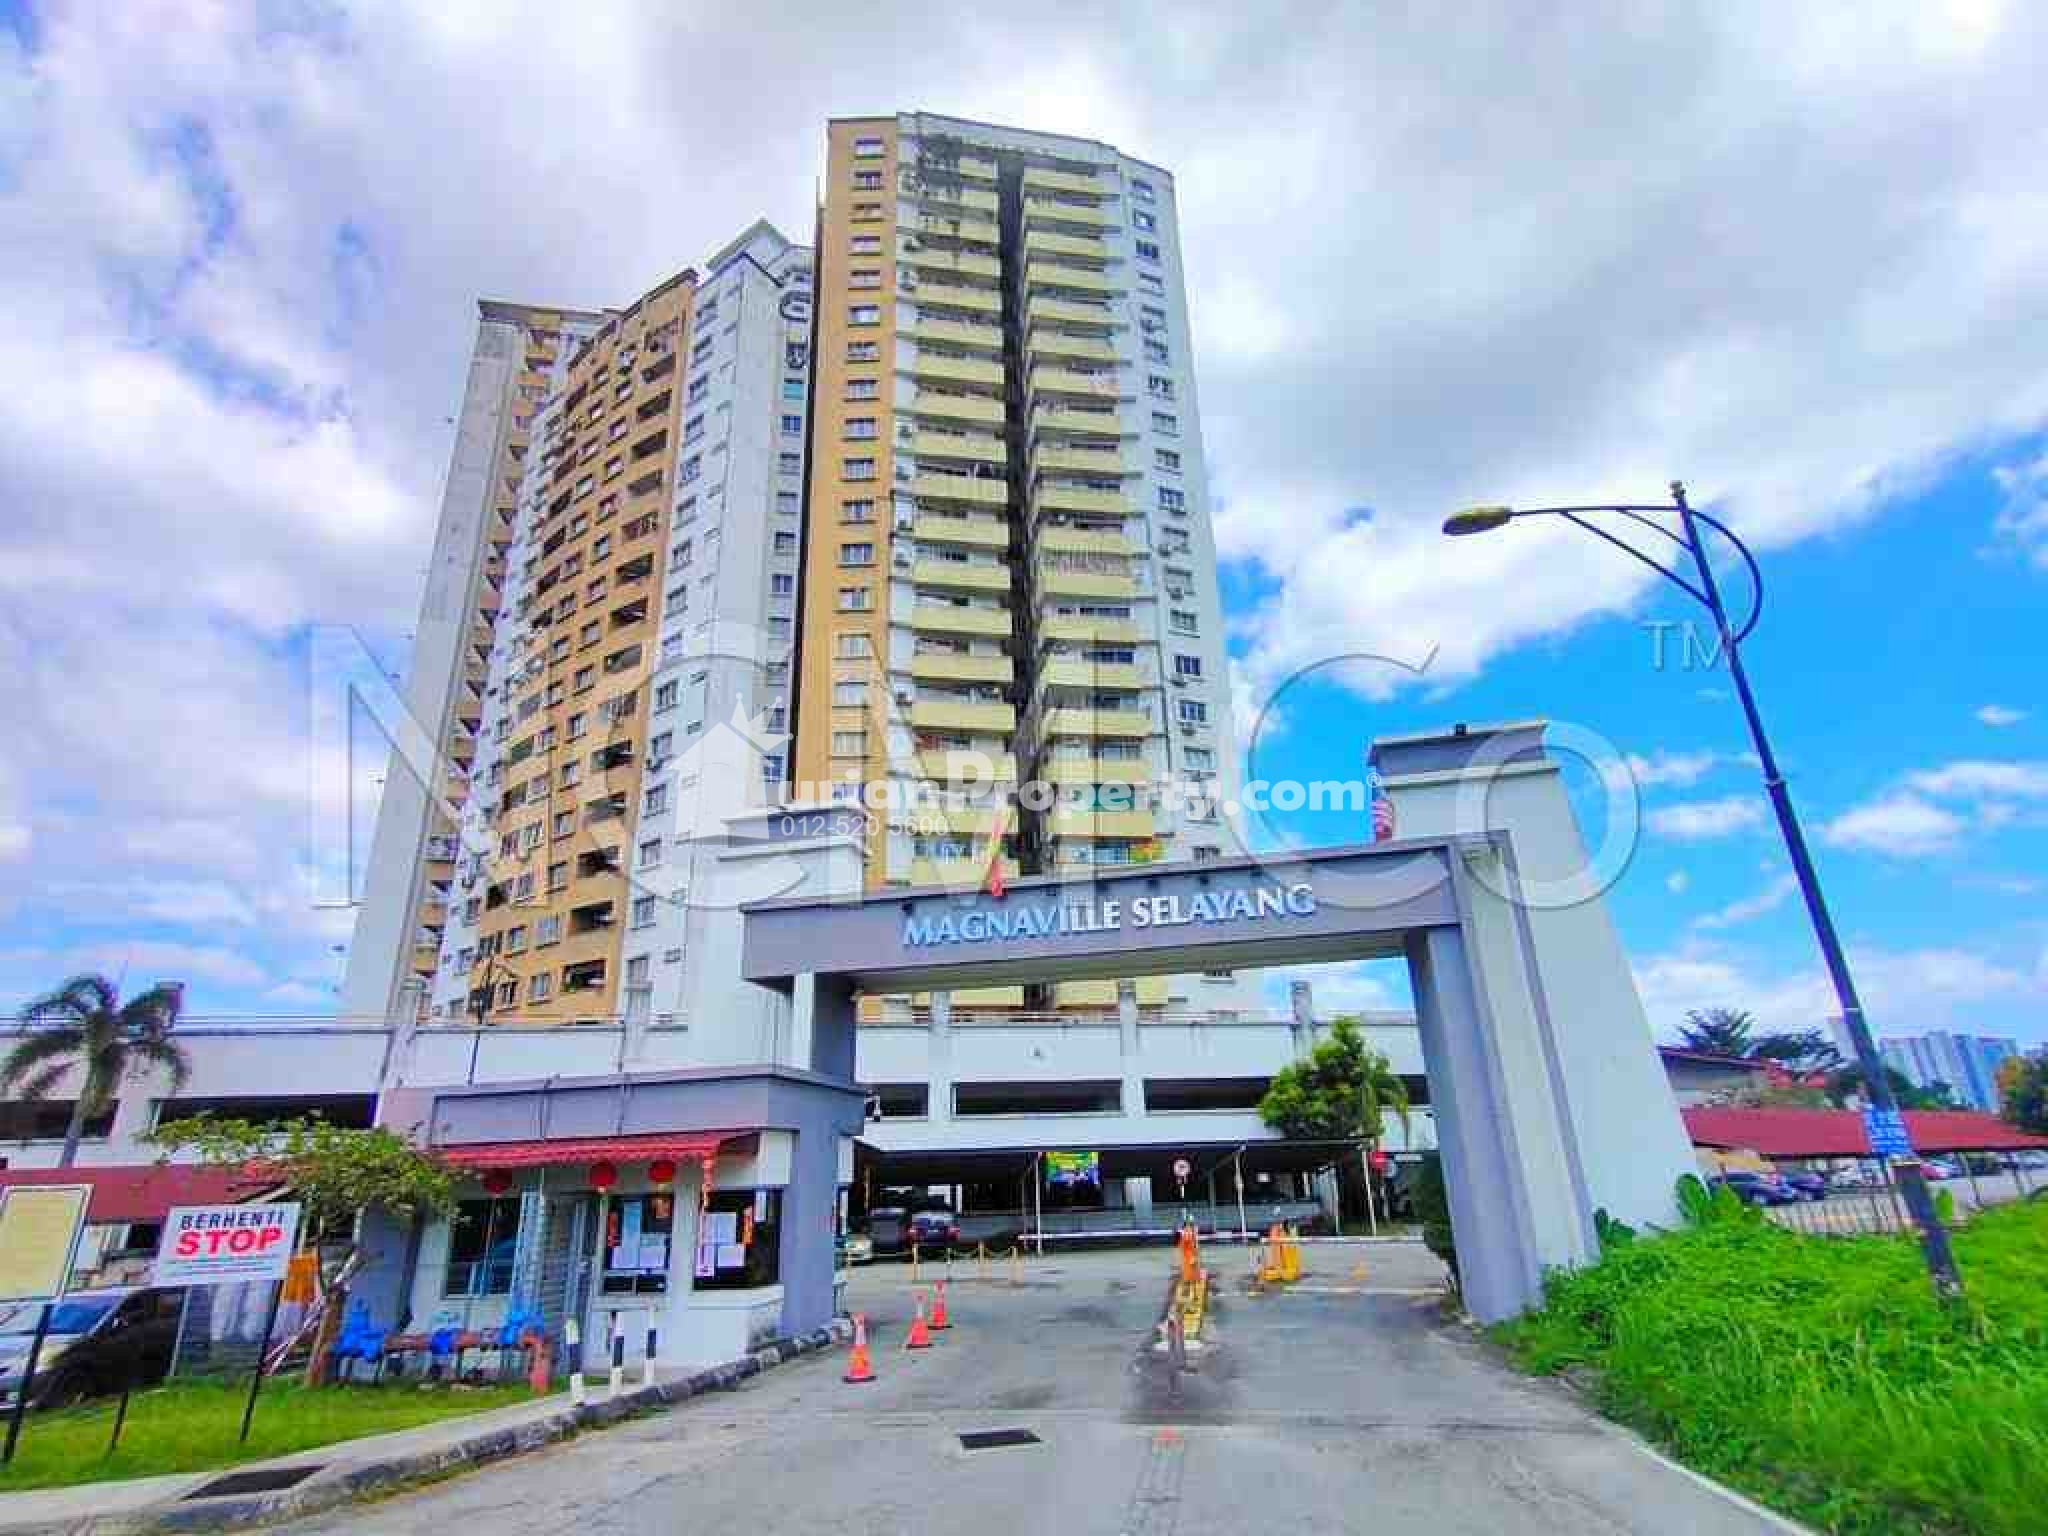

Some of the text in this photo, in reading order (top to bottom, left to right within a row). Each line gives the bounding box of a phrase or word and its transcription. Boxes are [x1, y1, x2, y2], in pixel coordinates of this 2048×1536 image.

[903, 883, 1317, 946] MAGNAVILLE SELAYANG
[179, 1209, 285, 1230] BERHENTI
[175, 1226, 282, 1255] STOP
